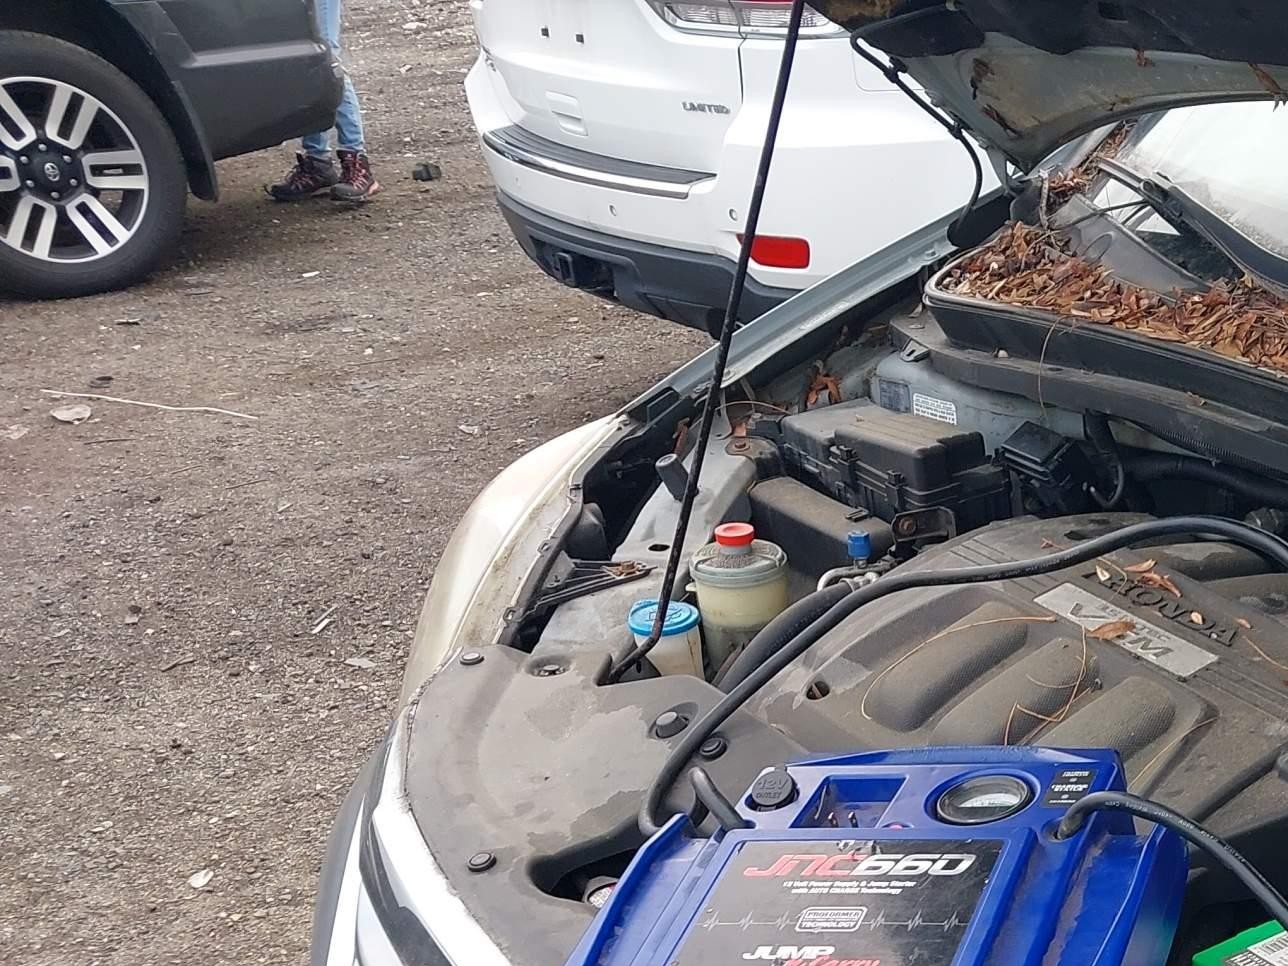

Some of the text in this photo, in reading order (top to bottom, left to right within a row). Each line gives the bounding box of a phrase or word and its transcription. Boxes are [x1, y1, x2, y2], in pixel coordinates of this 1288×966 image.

[681, 102, 731, 114] LIMITED
[1068, 602, 1174, 660] VM
[758, 778, 789, 790] 12V
[742, 945, 835, 960] JUMP
